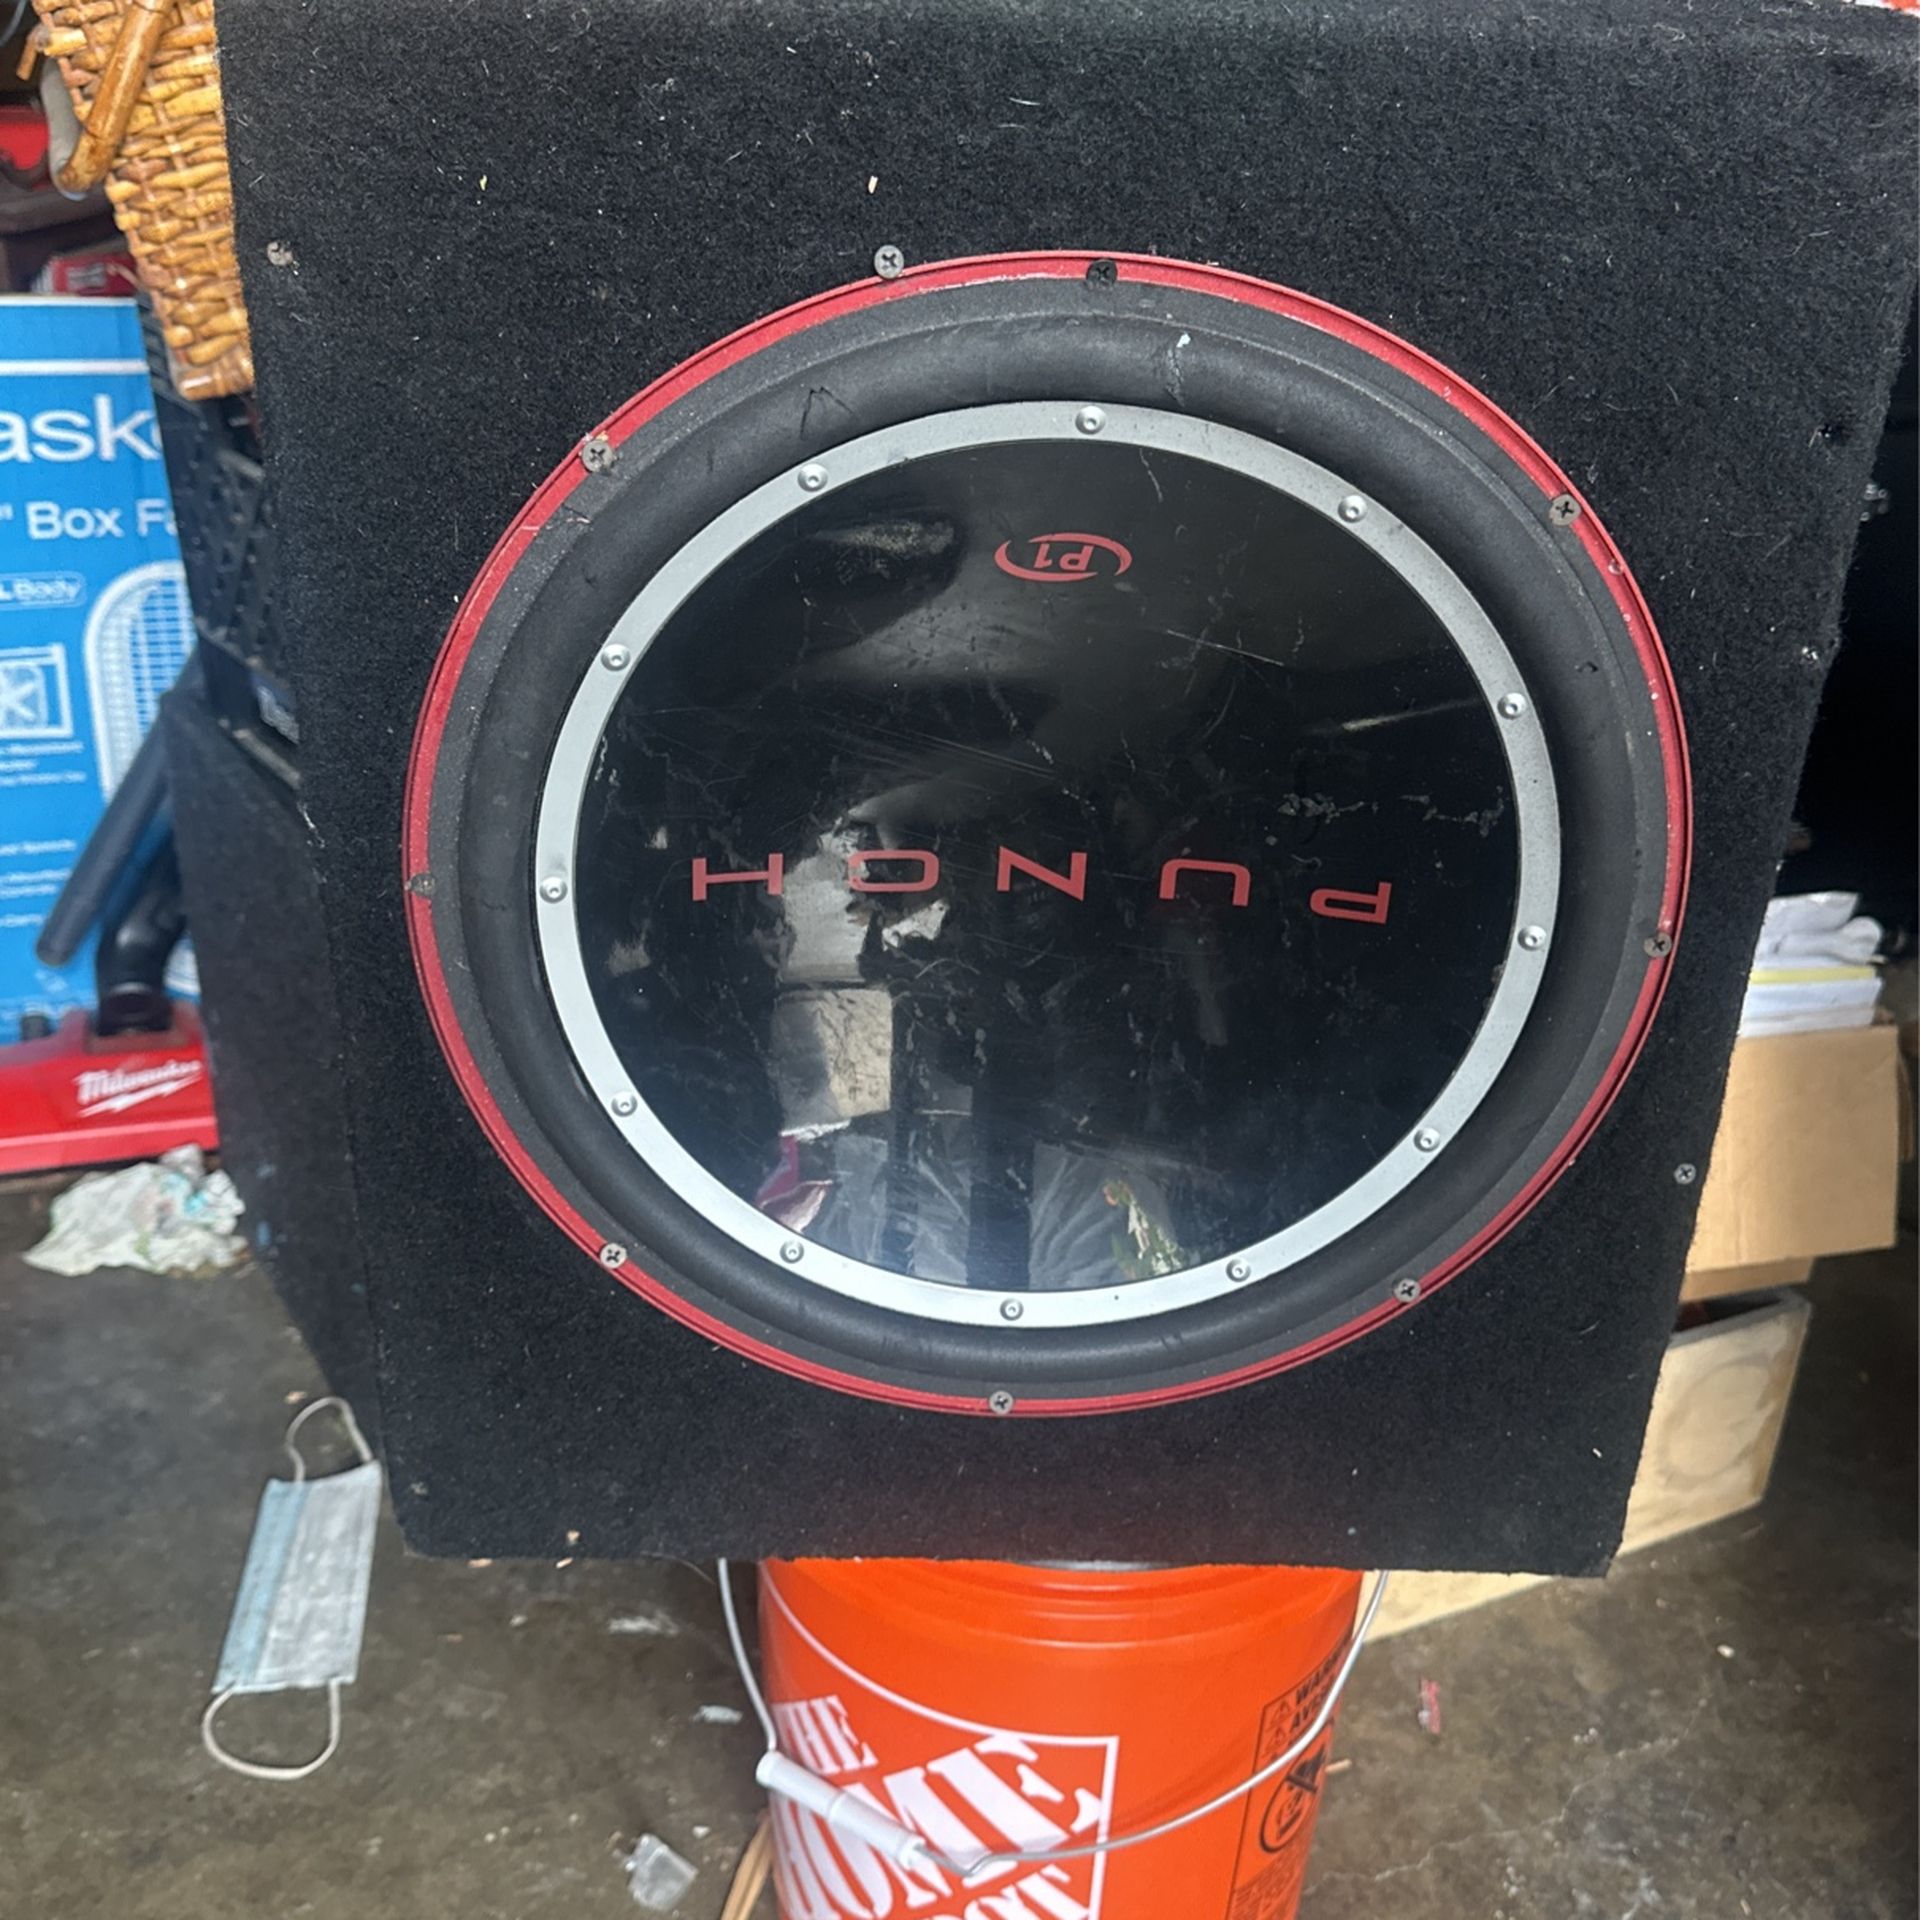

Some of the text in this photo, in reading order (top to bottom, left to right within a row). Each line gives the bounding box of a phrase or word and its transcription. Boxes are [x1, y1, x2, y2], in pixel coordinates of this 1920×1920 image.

[0, 393, 163, 463] ask
[26, 501, 124, 540] Box
[1033, 542, 1095, 572] P1
[692, 848, 1390, 924] PUNCH
[770, 1693, 880, 1777] THE
[766, 1732, 1101, 1920] HOME
